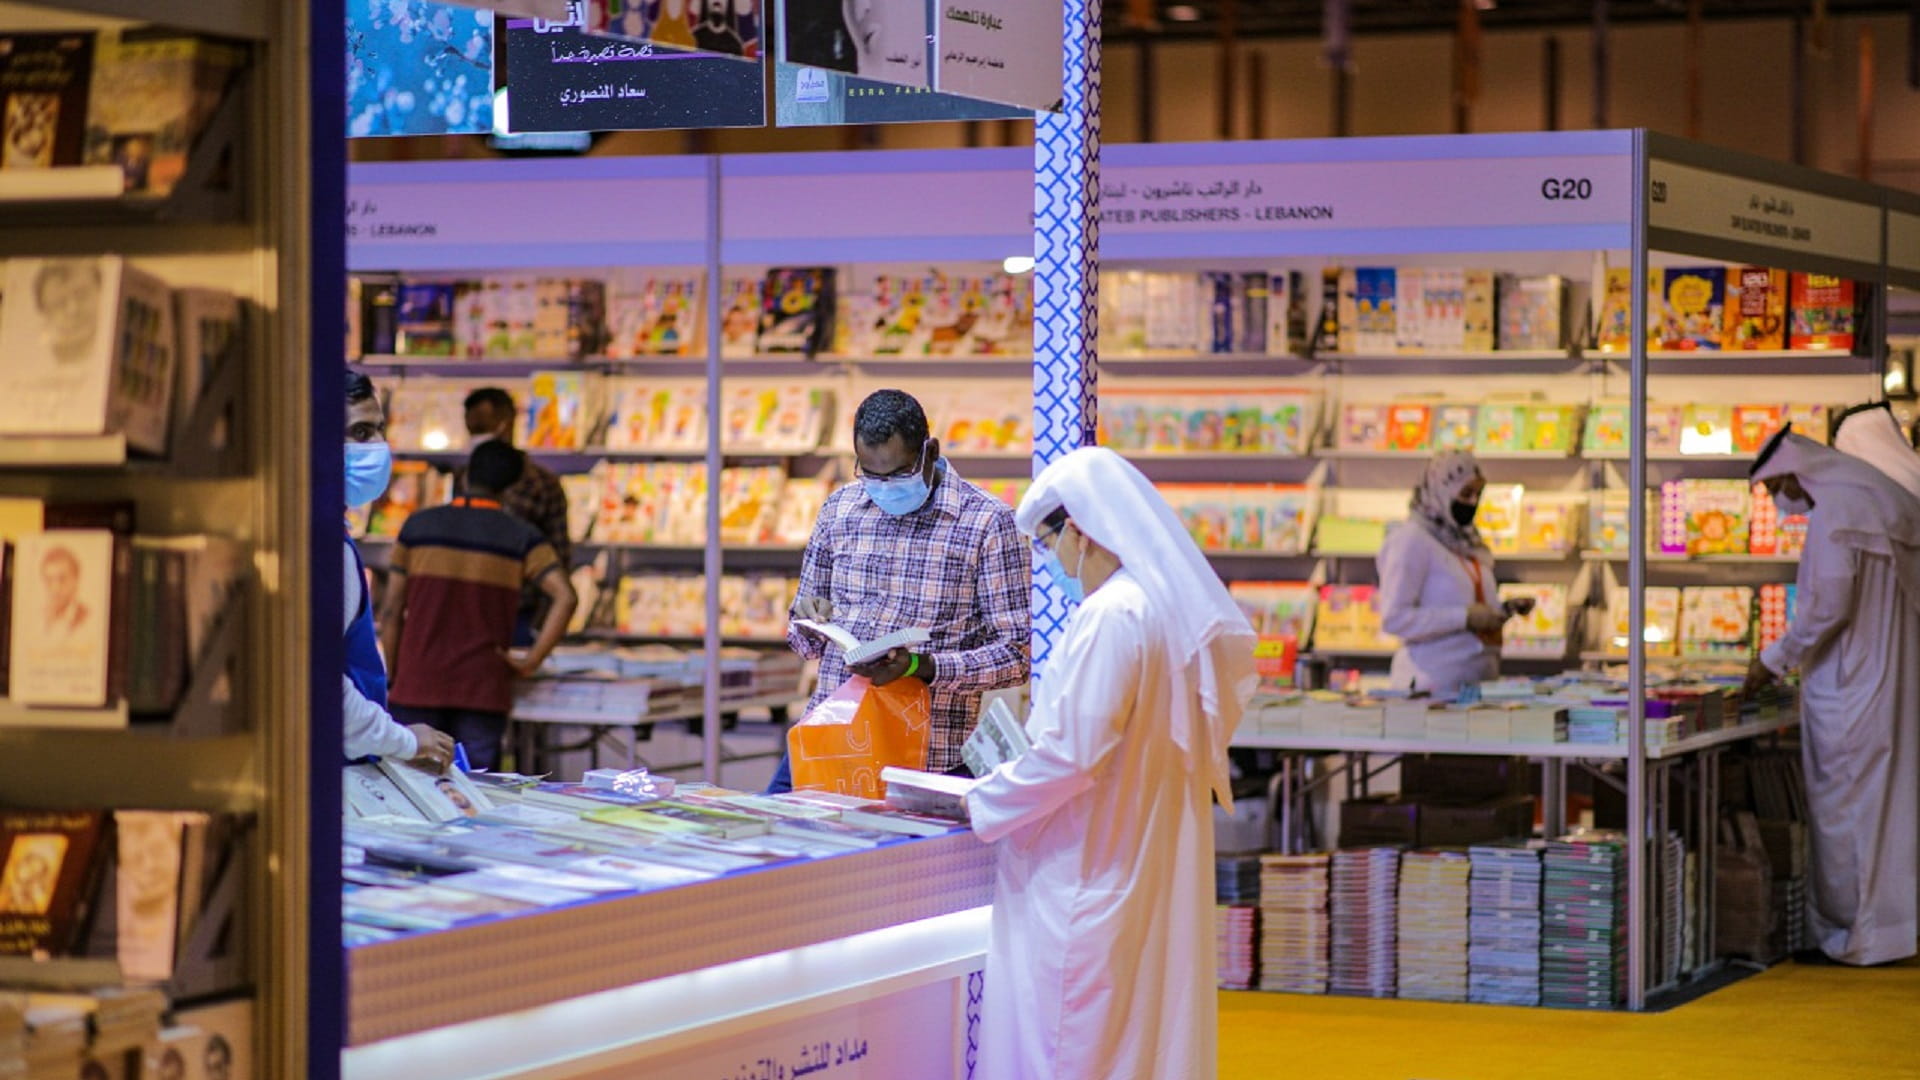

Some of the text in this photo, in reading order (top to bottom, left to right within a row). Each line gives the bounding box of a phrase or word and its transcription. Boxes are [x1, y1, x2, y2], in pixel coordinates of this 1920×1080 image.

[560, 83, 646, 106] سعاد المنصوري
[1243, 180, 1262, 198] دار
[1541, 178, 1592, 199] G20
[1099, 209, 1135, 223] ATEB
[1140, 207, 1240, 222] PUBLISHERS
[1255, 205, 1334, 220] LEBANON
